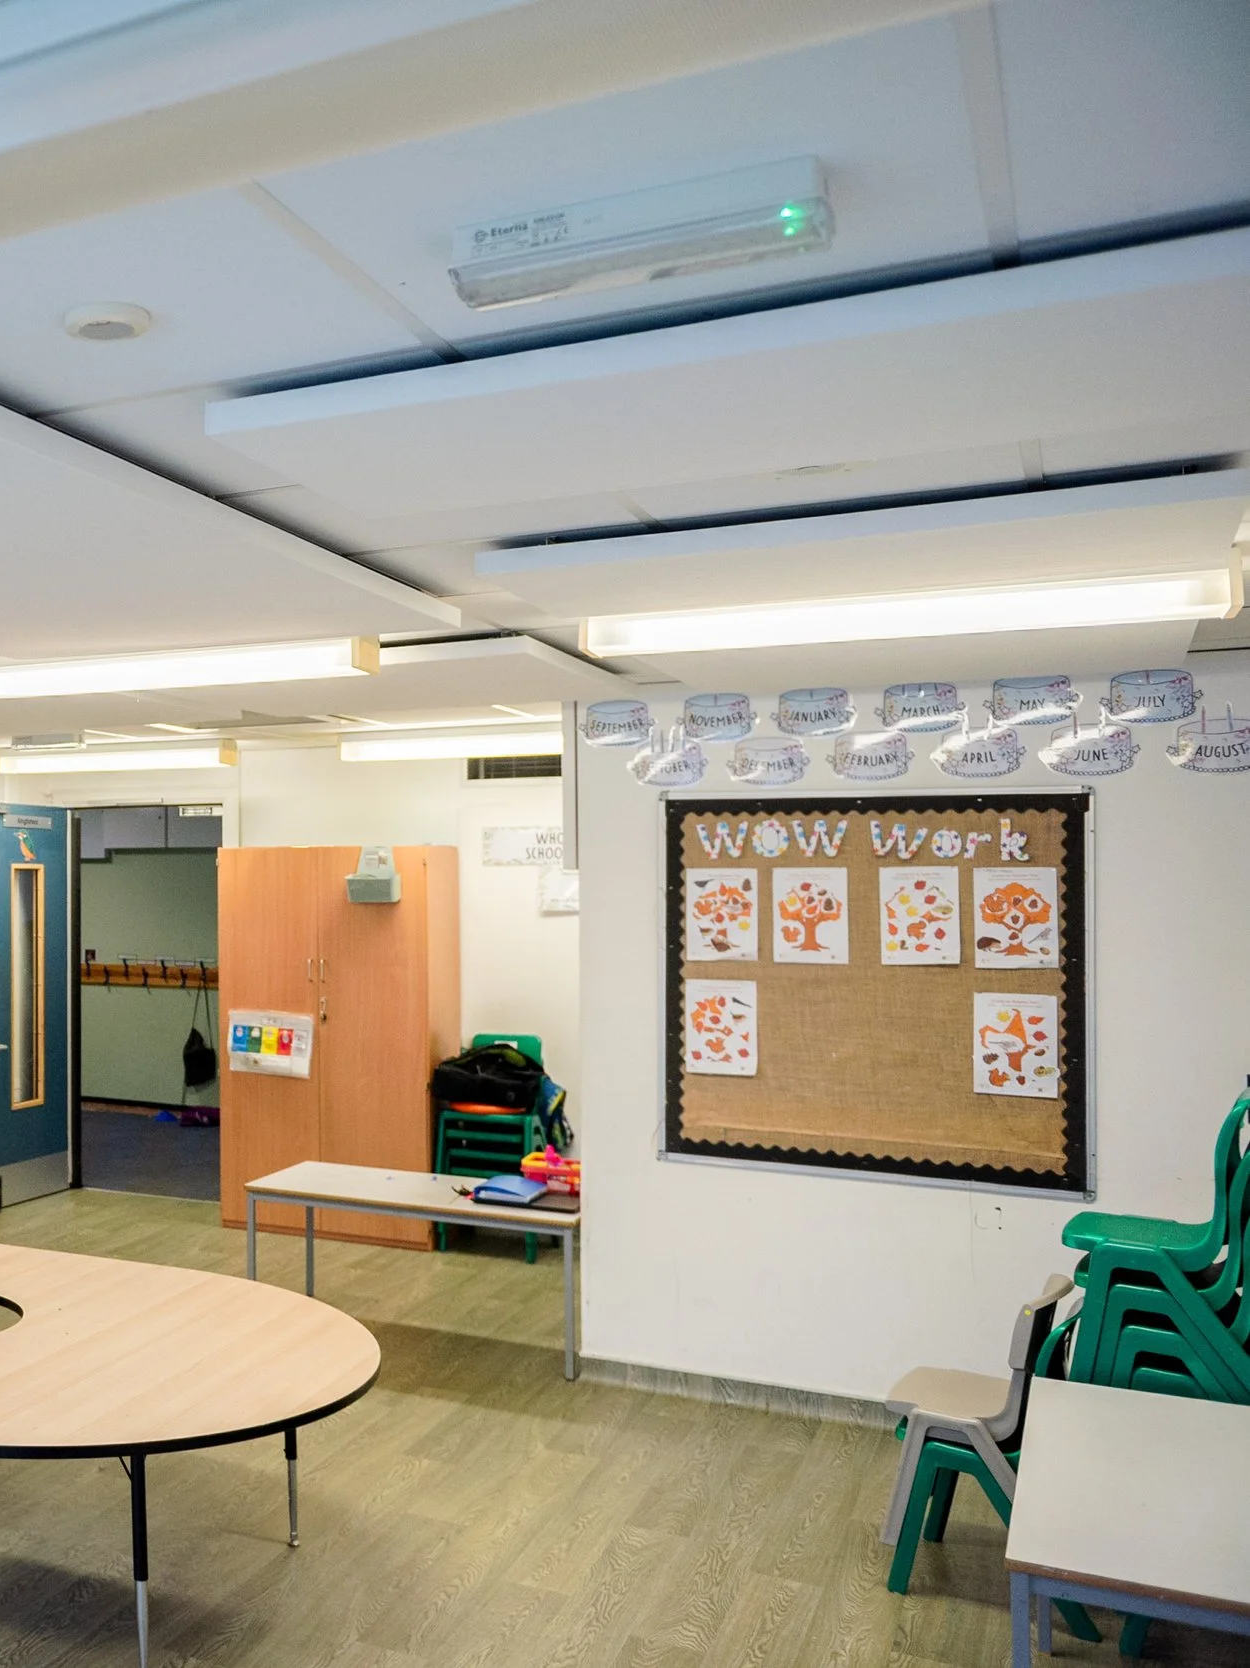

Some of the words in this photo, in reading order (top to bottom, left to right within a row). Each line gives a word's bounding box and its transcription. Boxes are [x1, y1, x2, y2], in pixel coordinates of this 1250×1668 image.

[491, 222, 528, 237] Eterna
[1019, 698, 1046, 711] MAY
[1134, 694, 1166, 708] JULY
[790, 707, 838, 723] JANUARY
[901, 705, 941, 718] MARCH
[590, 718, 645, 733] SEPTEMBER
[689, 711, 746, 728] NOVEMBER
[961, 751, 996, 763] APRIL
[1074, 748, 1109, 762] JUNE
[1194, 742, 1248, 758] AUGUST
[844, 751, 899, 767] FEBRUARY
[695, 818, 848, 860] WOW
[869, 817, 1031, 862] Work
